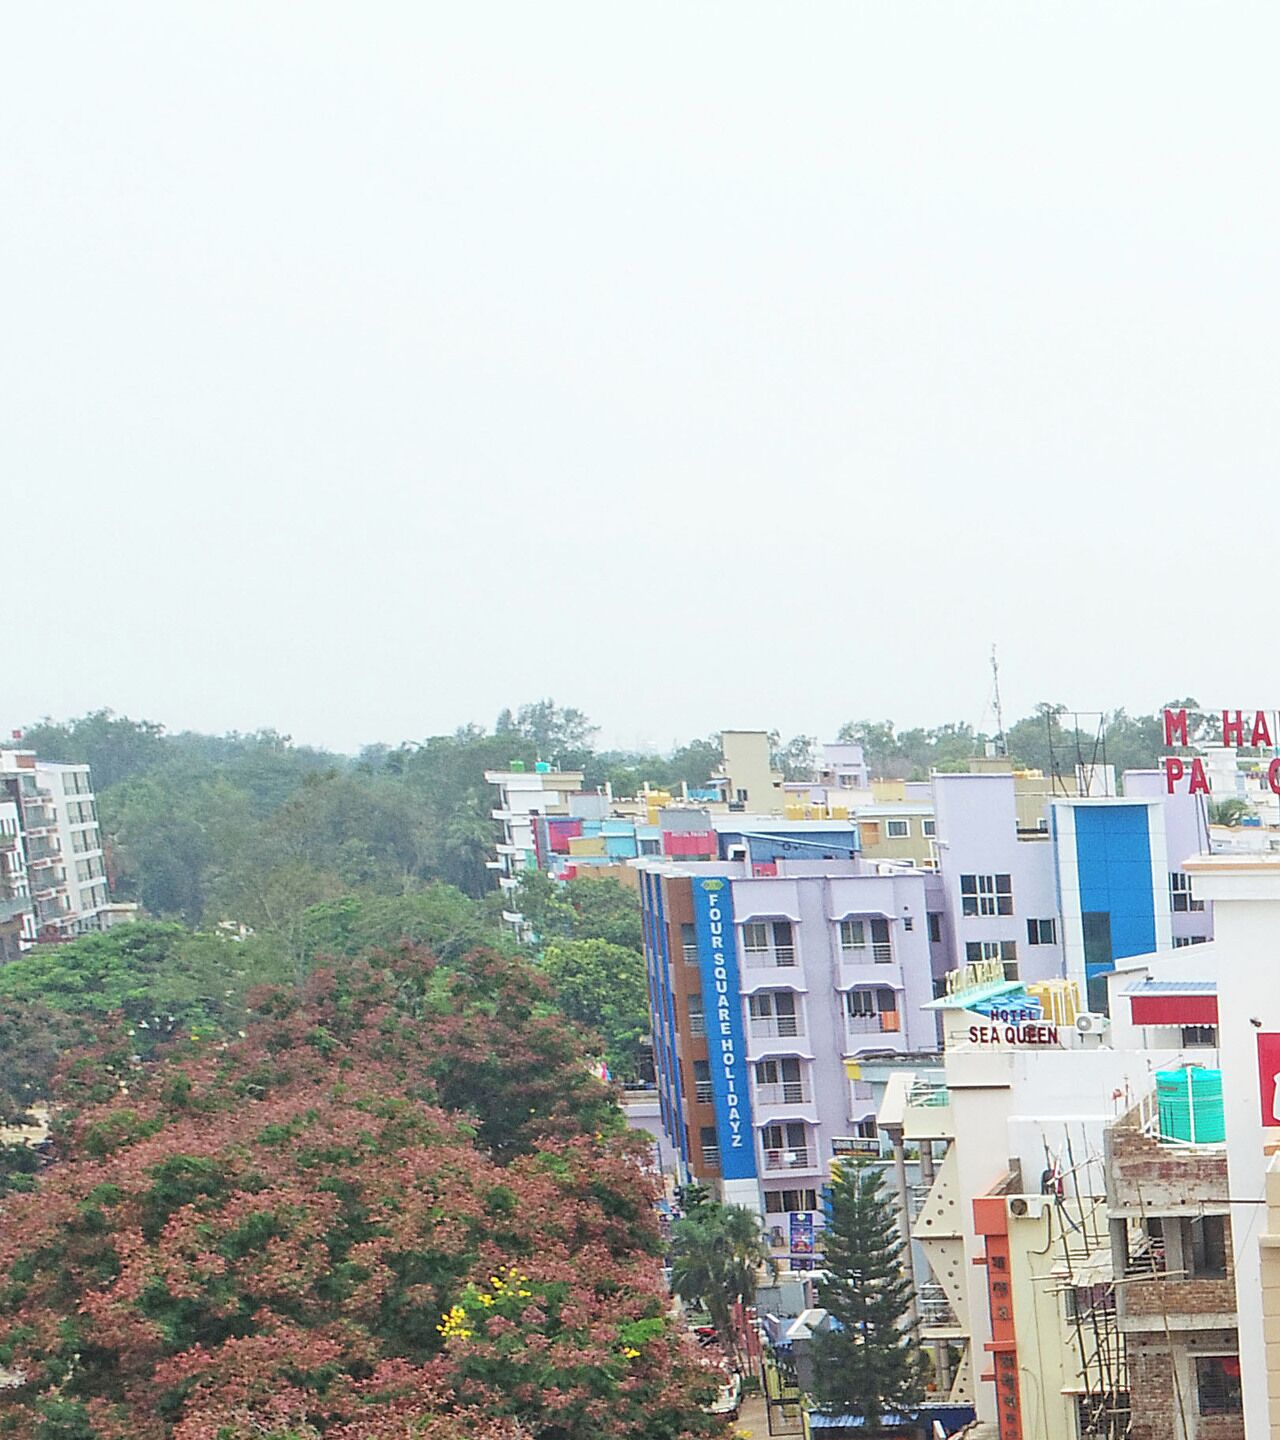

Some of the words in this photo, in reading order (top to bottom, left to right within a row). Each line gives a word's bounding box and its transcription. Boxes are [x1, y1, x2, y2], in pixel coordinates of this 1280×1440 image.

[708, 893, 723, 949] FOUR
[713, 952, 731, 1035] SQUARE
[990, 1009, 1036, 1021] HOTEL
[969, 1026, 1001, 1043] SEA
[1004, 1025, 1059, 1045] QUEEN
[720, 1038, 743, 1148] HOLIDAYZ
